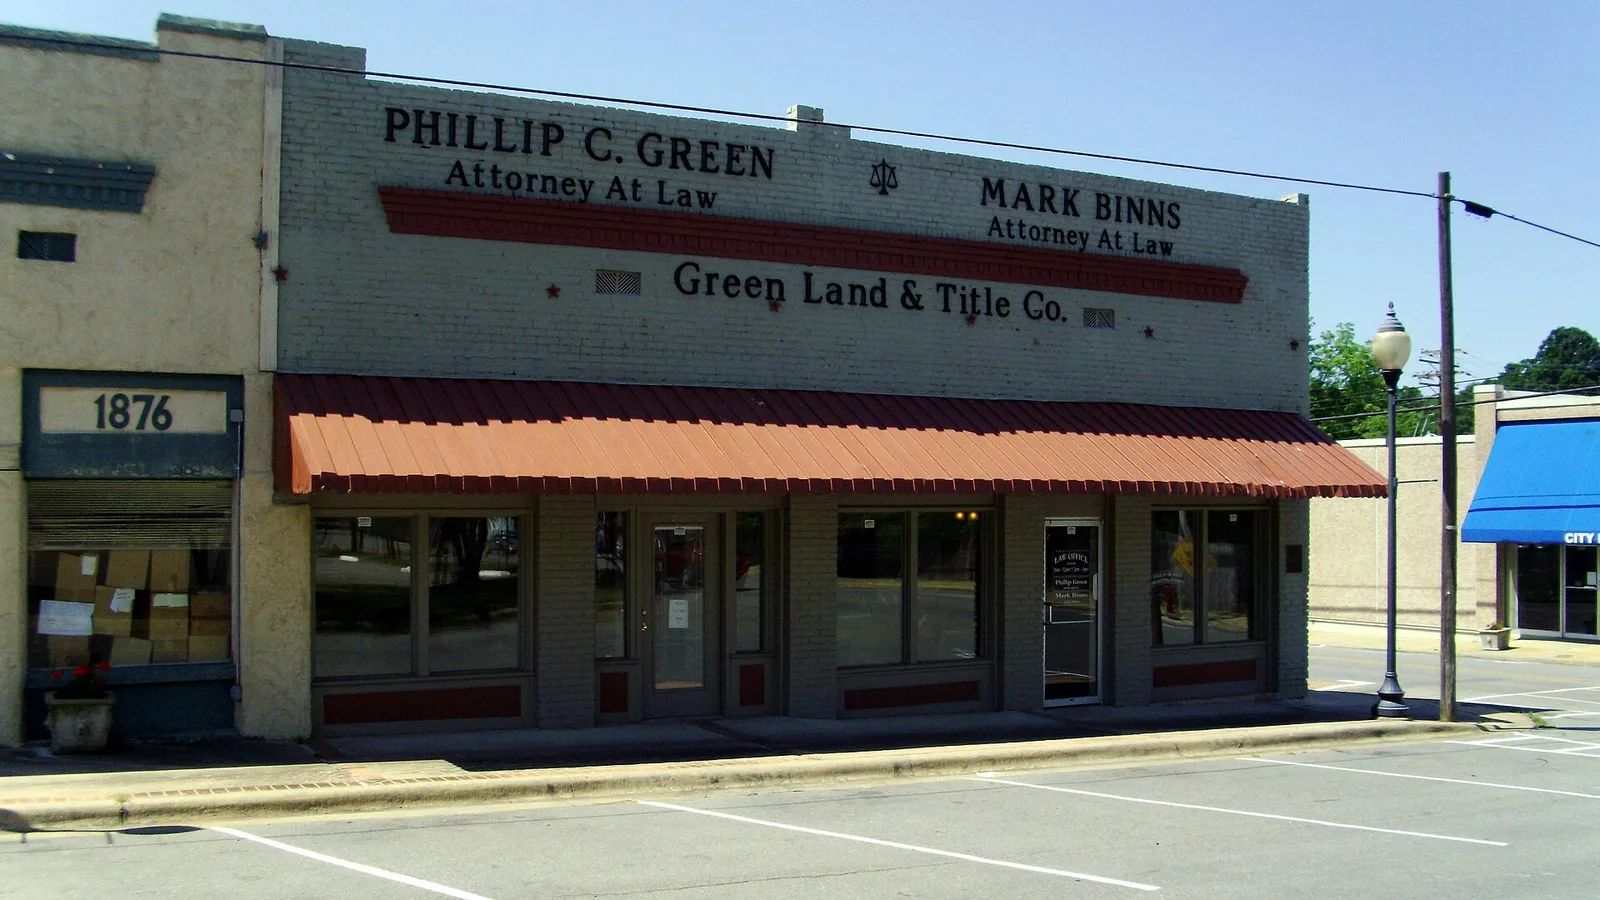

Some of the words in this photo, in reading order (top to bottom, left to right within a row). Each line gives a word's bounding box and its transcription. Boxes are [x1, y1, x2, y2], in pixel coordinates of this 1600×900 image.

[384, 107, 565, 156] PHILLIP
[585, 127, 623, 164] C.
[637, 132, 775, 180] GREEN
[445, 160, 595, 202] Attorney
[605, 175, 642, 202] At
[657, 180, 718, 210] Law
[980, 177, 1081, 217] MARK
[1095, 192, 1181, 230] BINNS
[987, 216, 1090, 252] Attorney
[1097, 228, 1122, 250] At
[1132, 232, 1175, 257] Law
[673, 261, 785, 302] Green
[803, 272, 889, 308] Land
[900, 279, 924, 311] &
[936, 283, 1011, 316] Title
[1023, 290, 1068, 323] Co.
[94, 393, 173, 430] 1876
[1054, 553, 1067, 564] LAW
[1067, 552, 1088, 564] OFFICE
[1564, 532, 1595, 544] CITY
